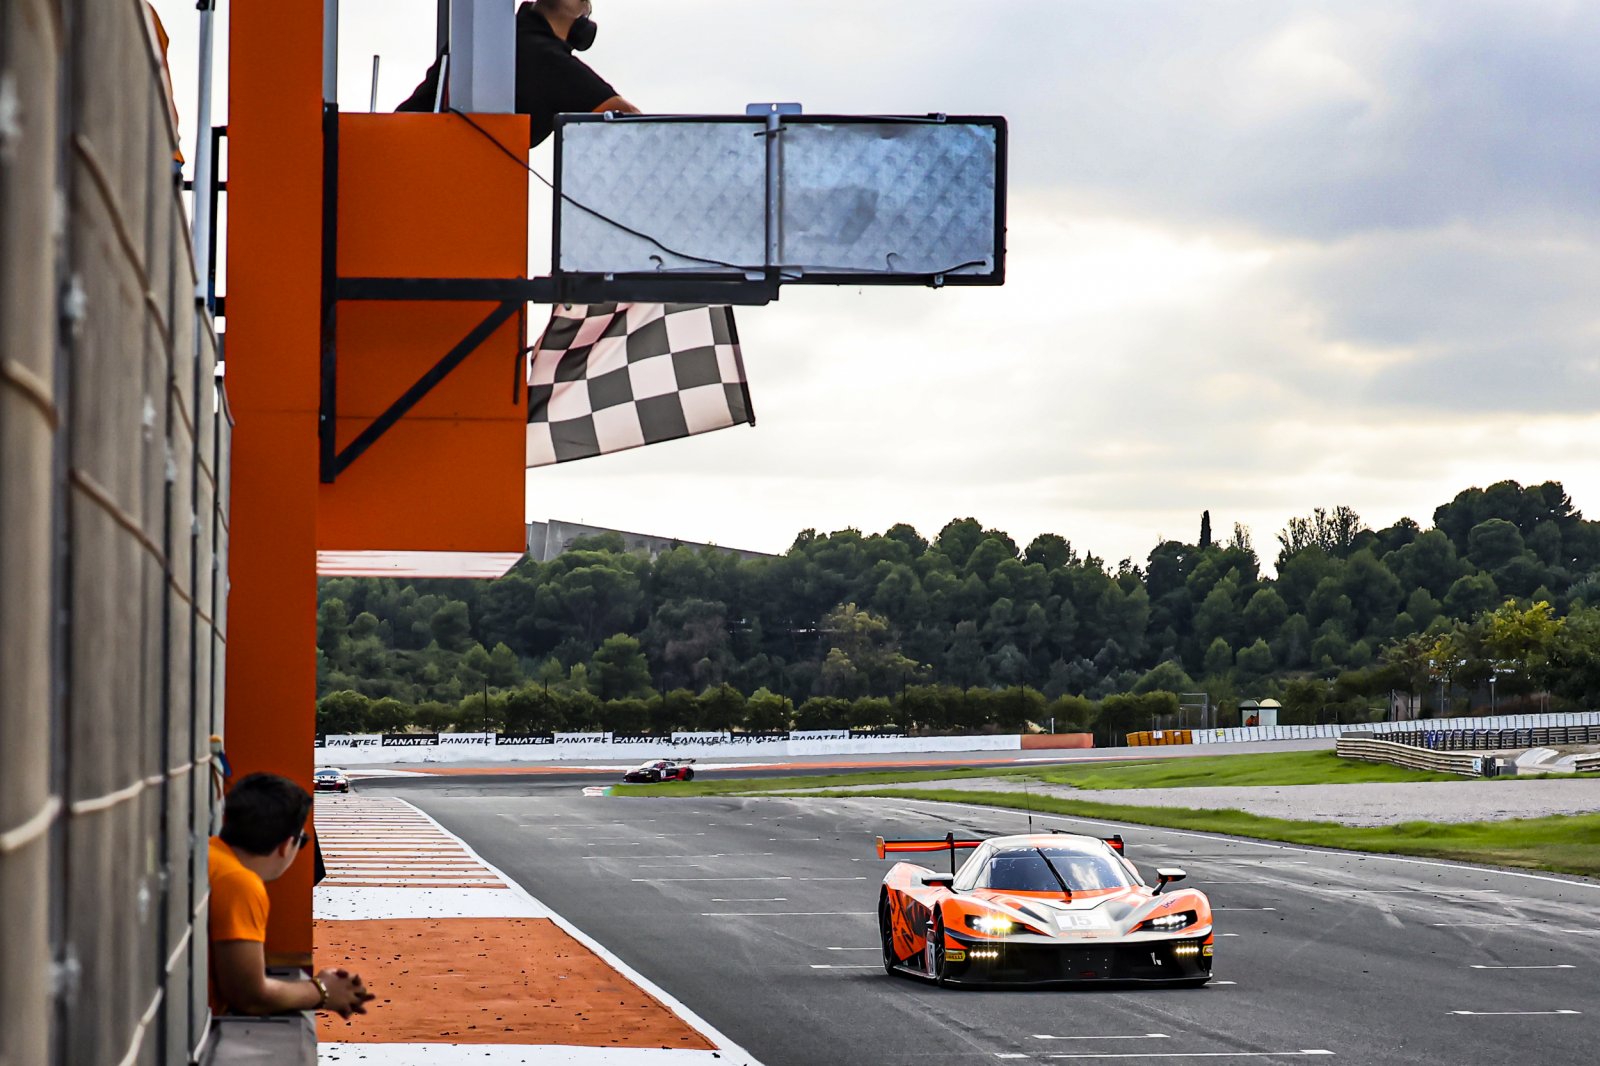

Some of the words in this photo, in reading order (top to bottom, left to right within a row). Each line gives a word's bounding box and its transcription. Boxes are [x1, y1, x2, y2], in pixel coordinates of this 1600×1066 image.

[383, 738, 438, 746] FANATEC
[440, 737, 494, 745] FANATEC
[497, 736, 553, 744] FANATEC
[555, 736, 610, 744] FANATEC
[613, 736, 670, 744] FANATEC
[671, 736, 728, 745] FANATEC
[1070, 916, 1092, 926] 15
